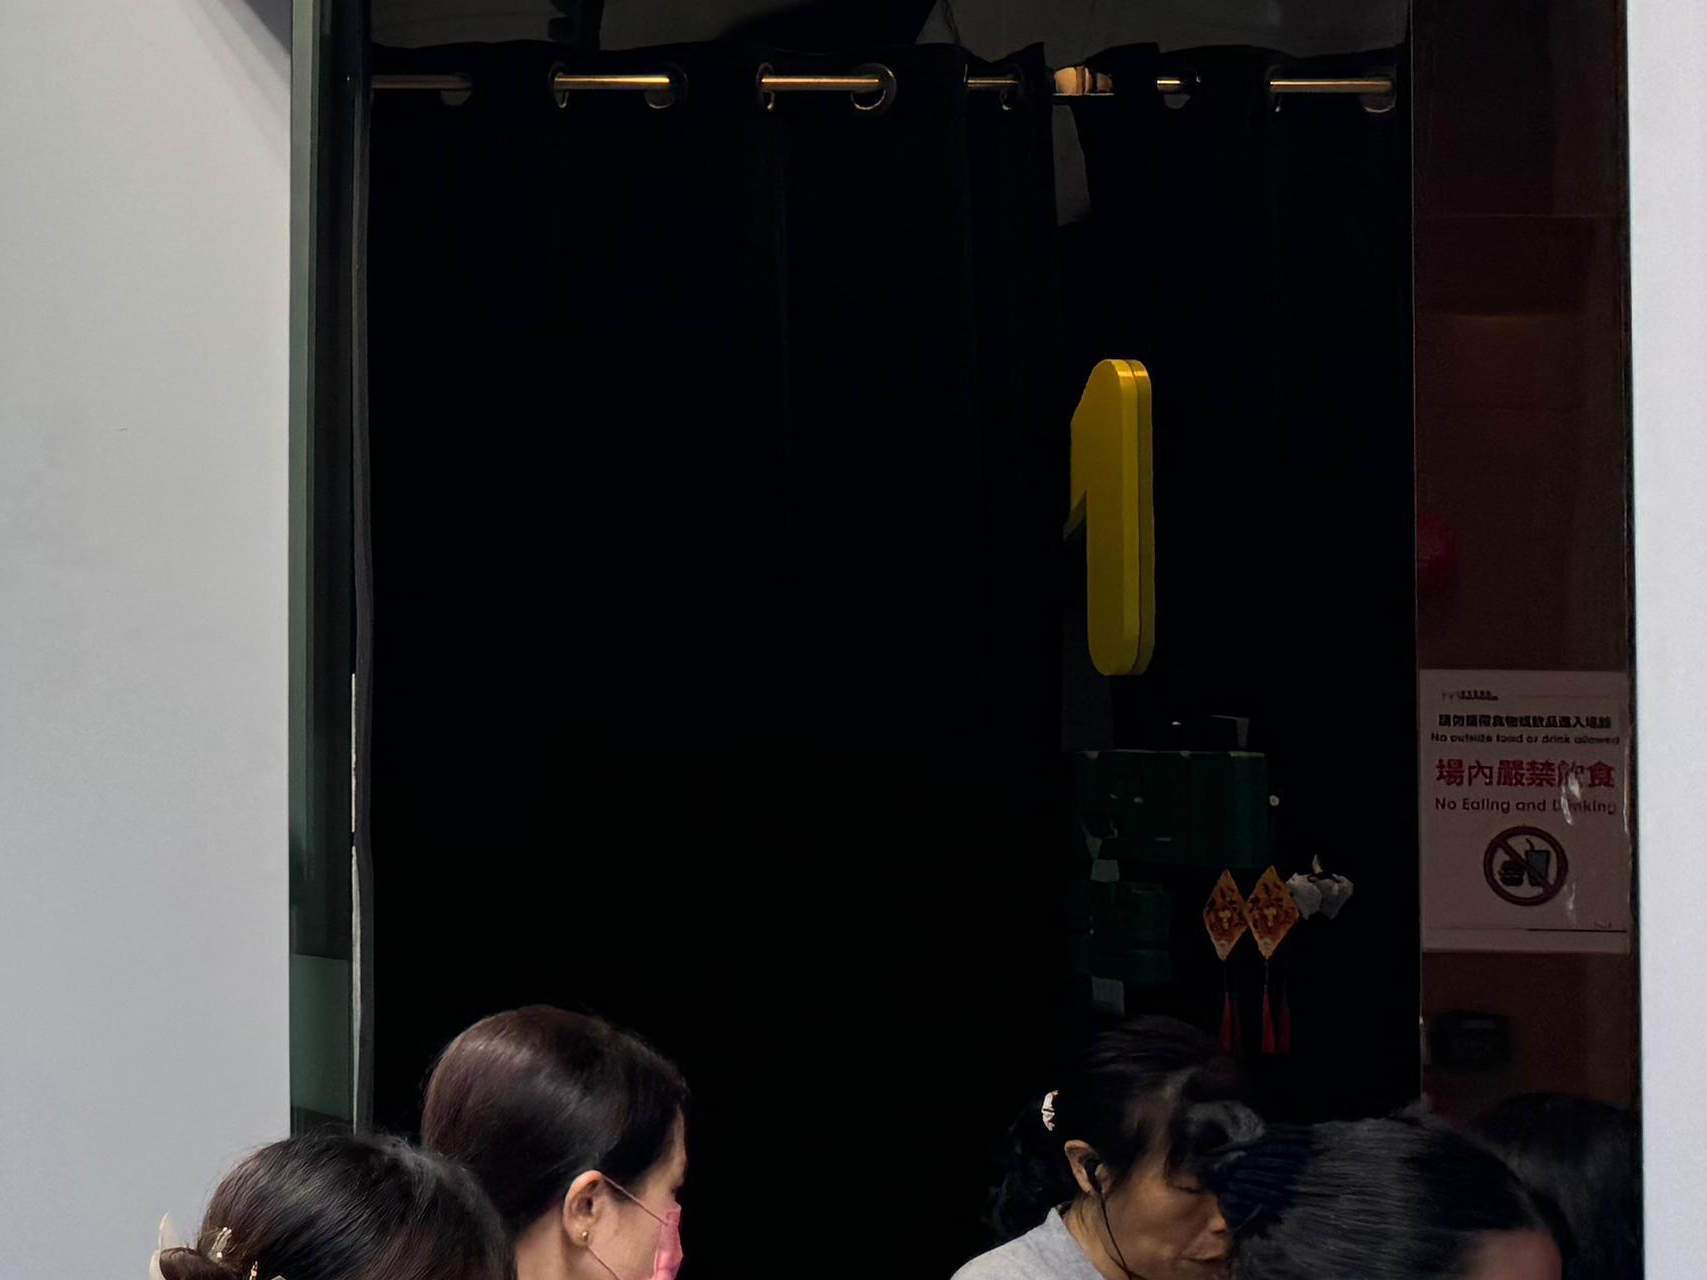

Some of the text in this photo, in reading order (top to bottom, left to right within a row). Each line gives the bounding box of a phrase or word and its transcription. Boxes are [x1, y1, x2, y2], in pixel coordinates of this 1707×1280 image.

[1434, 797, 1457, 812] No
[1462, 797, 1511, 815] Eating
[1515, 797, 1548, 813] and
